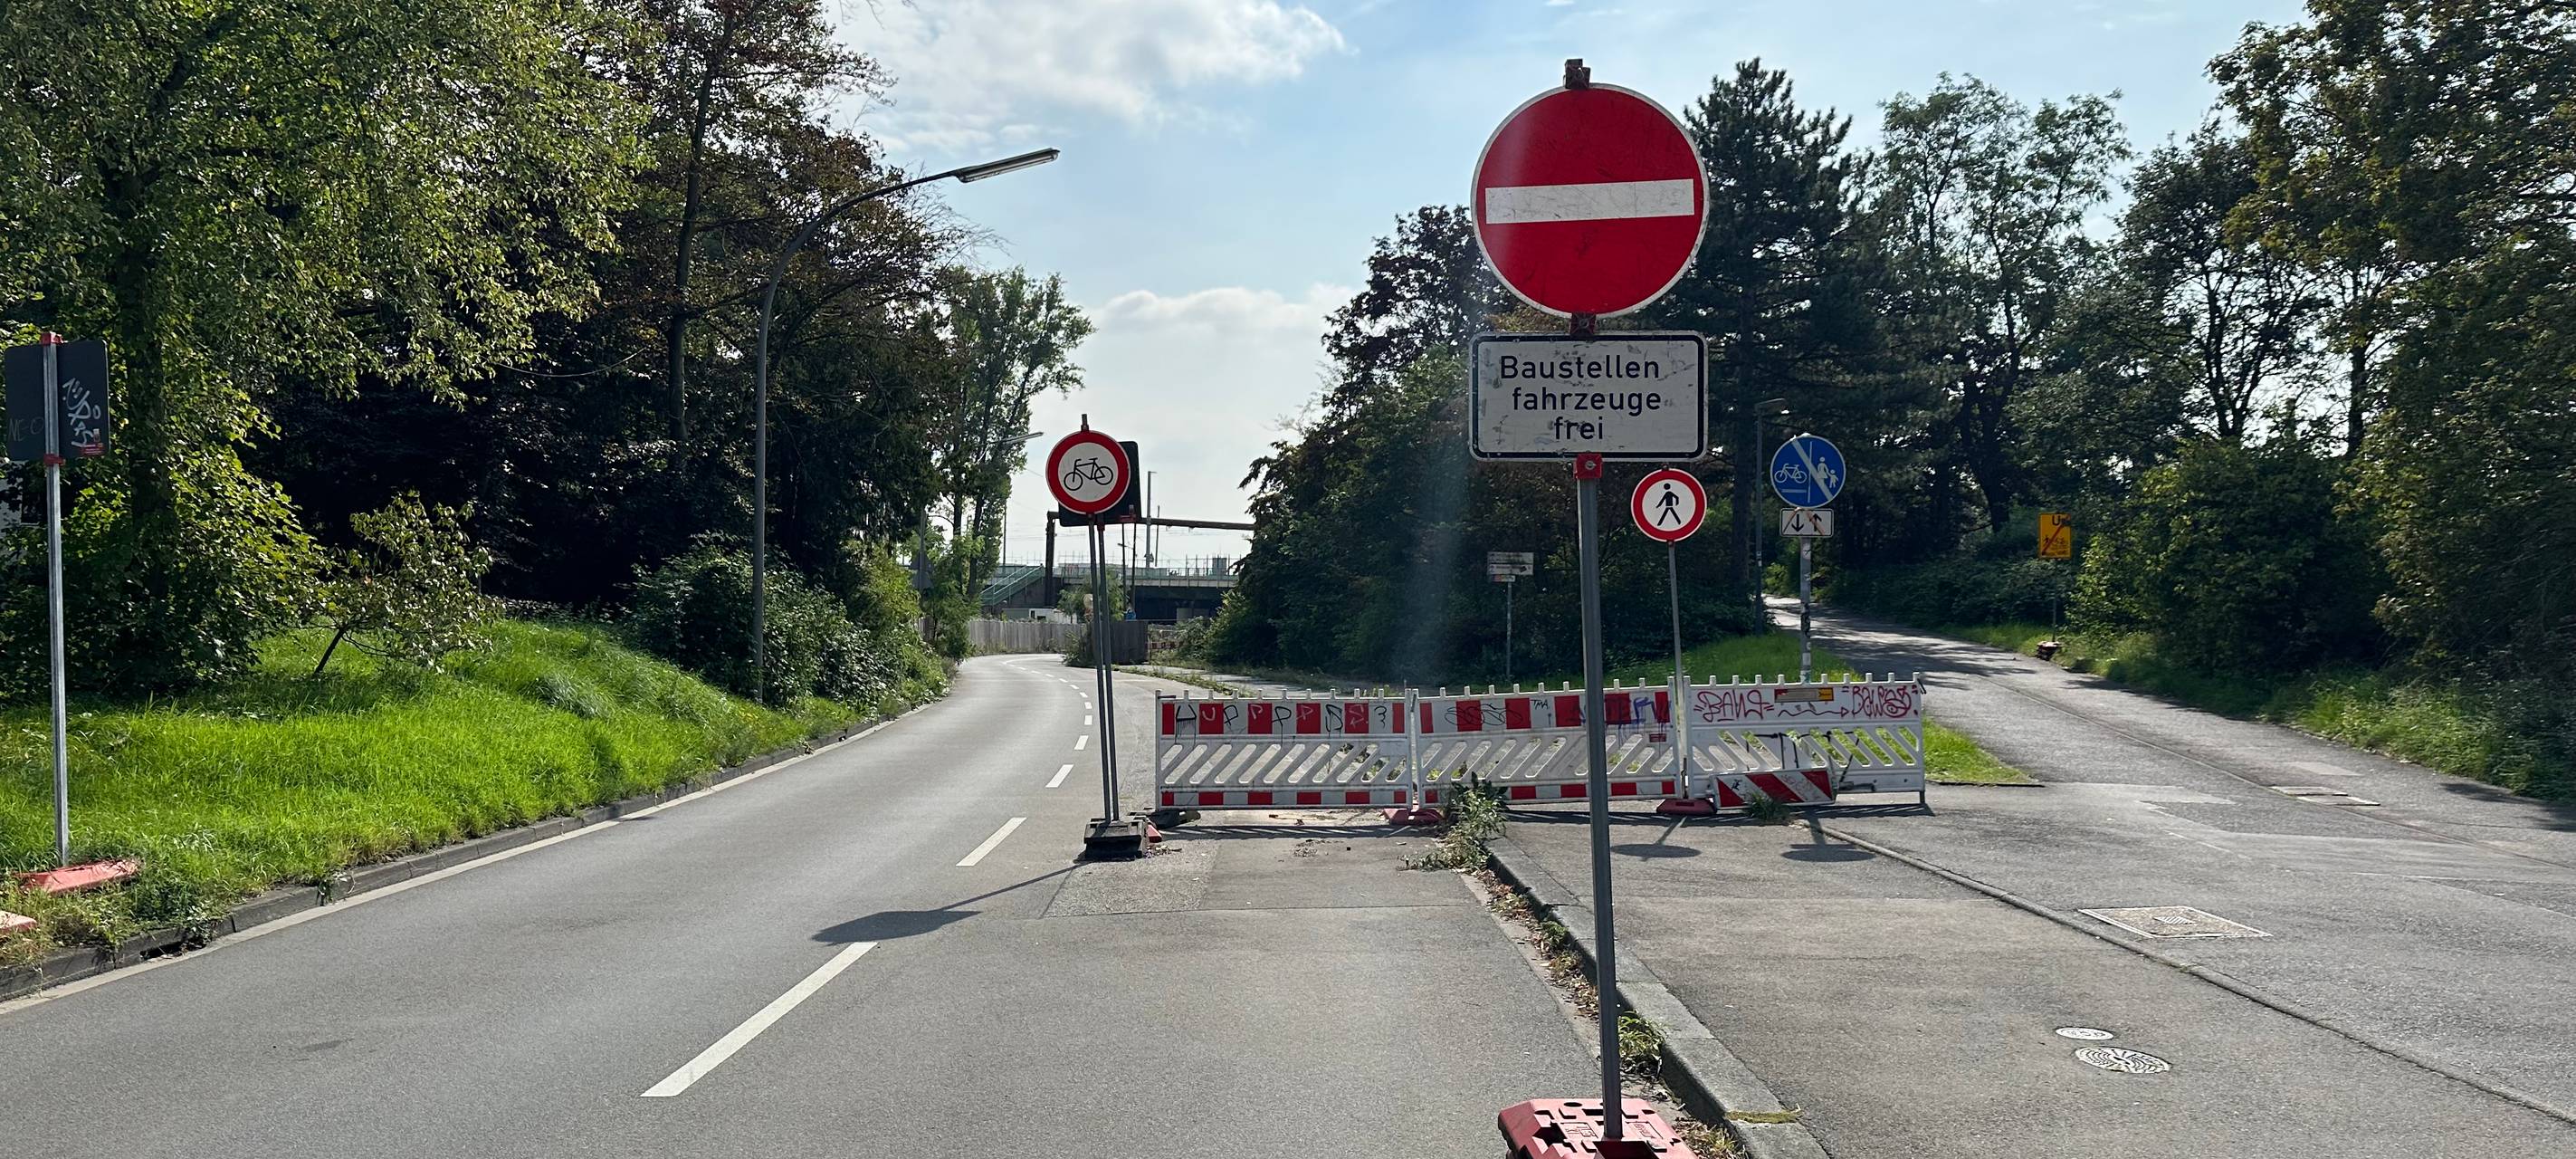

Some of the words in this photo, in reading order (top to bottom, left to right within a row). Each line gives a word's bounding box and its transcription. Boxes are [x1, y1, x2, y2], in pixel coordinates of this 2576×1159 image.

[1500, 354, 1660, 379] Baustellen
[1512, 387, 1661, 417] fahrzeuge
[1554, 417, 1605, 441] frei
